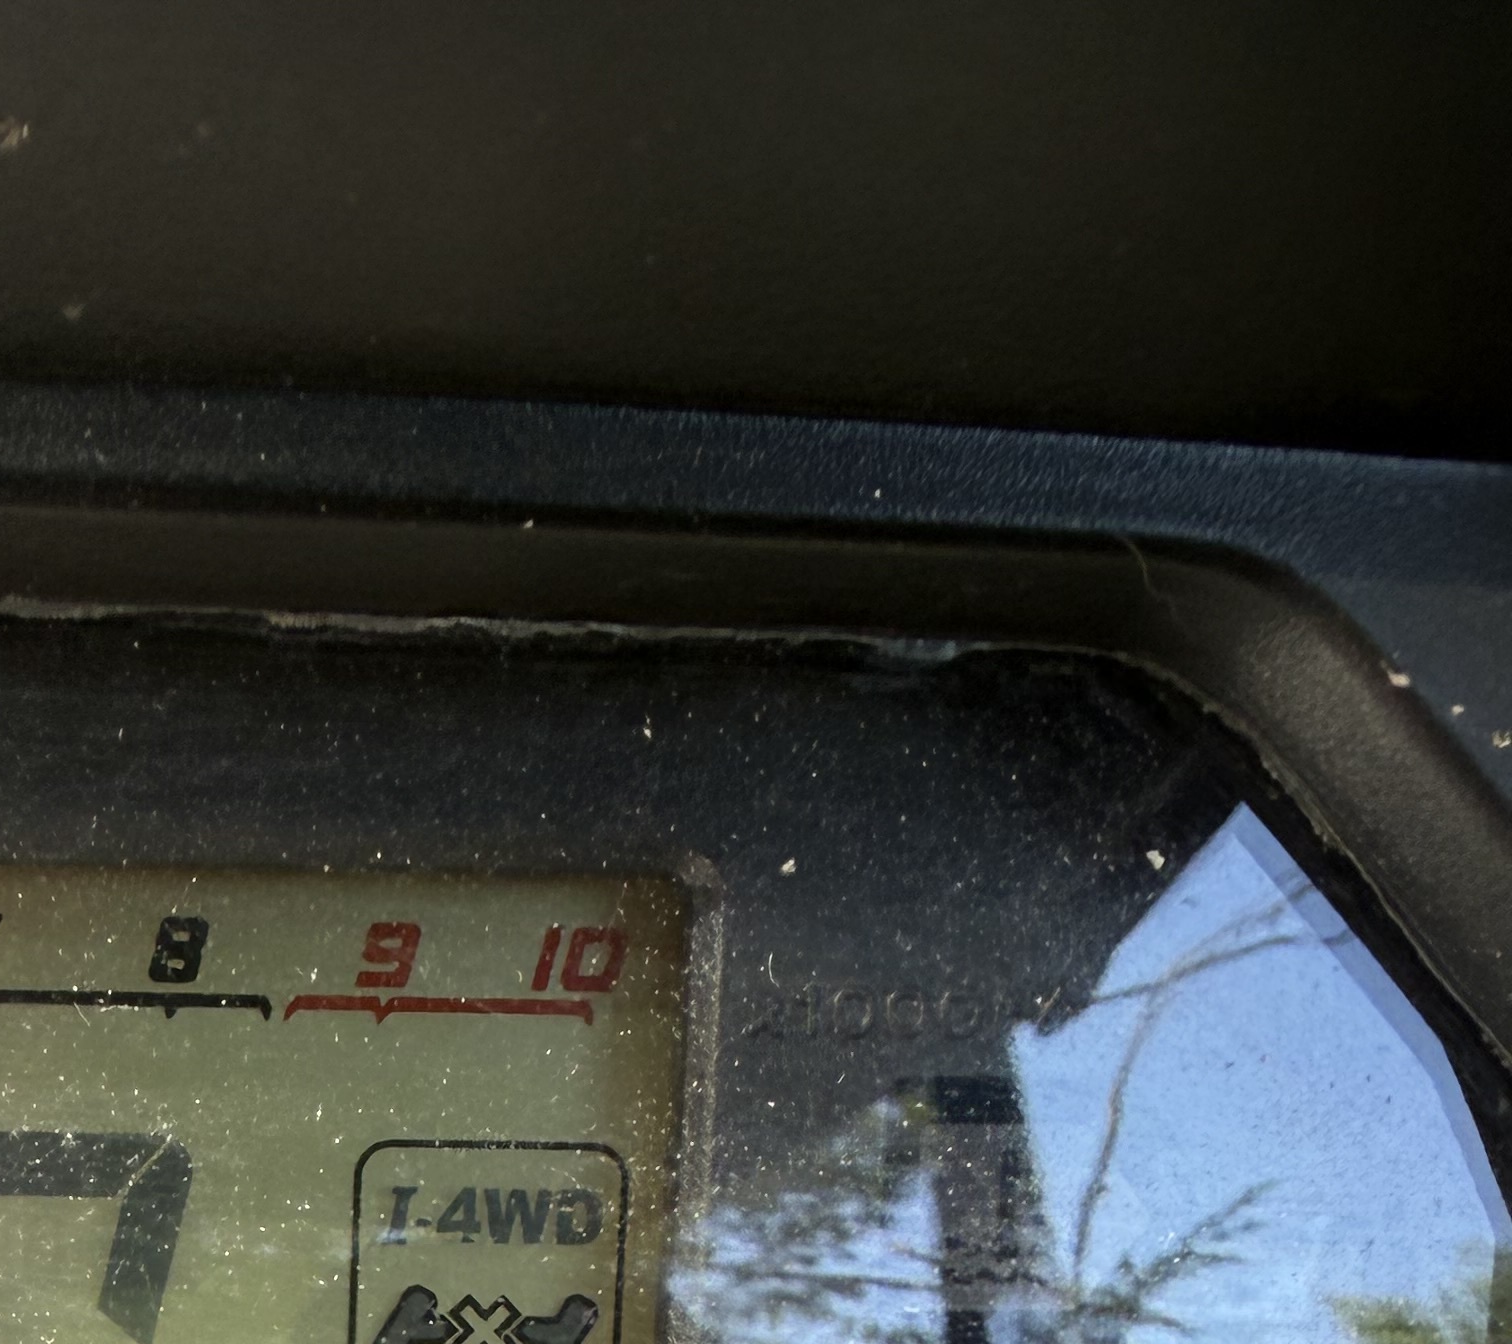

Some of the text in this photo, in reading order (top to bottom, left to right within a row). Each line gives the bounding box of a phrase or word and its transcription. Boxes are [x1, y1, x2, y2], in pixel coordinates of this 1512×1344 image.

[148, 916, 209, 984] 8
[354, 920, 422, 988] 9
[530, 924, 630, 994] 10
[382, 1185, 604, 1246] I-4WD
